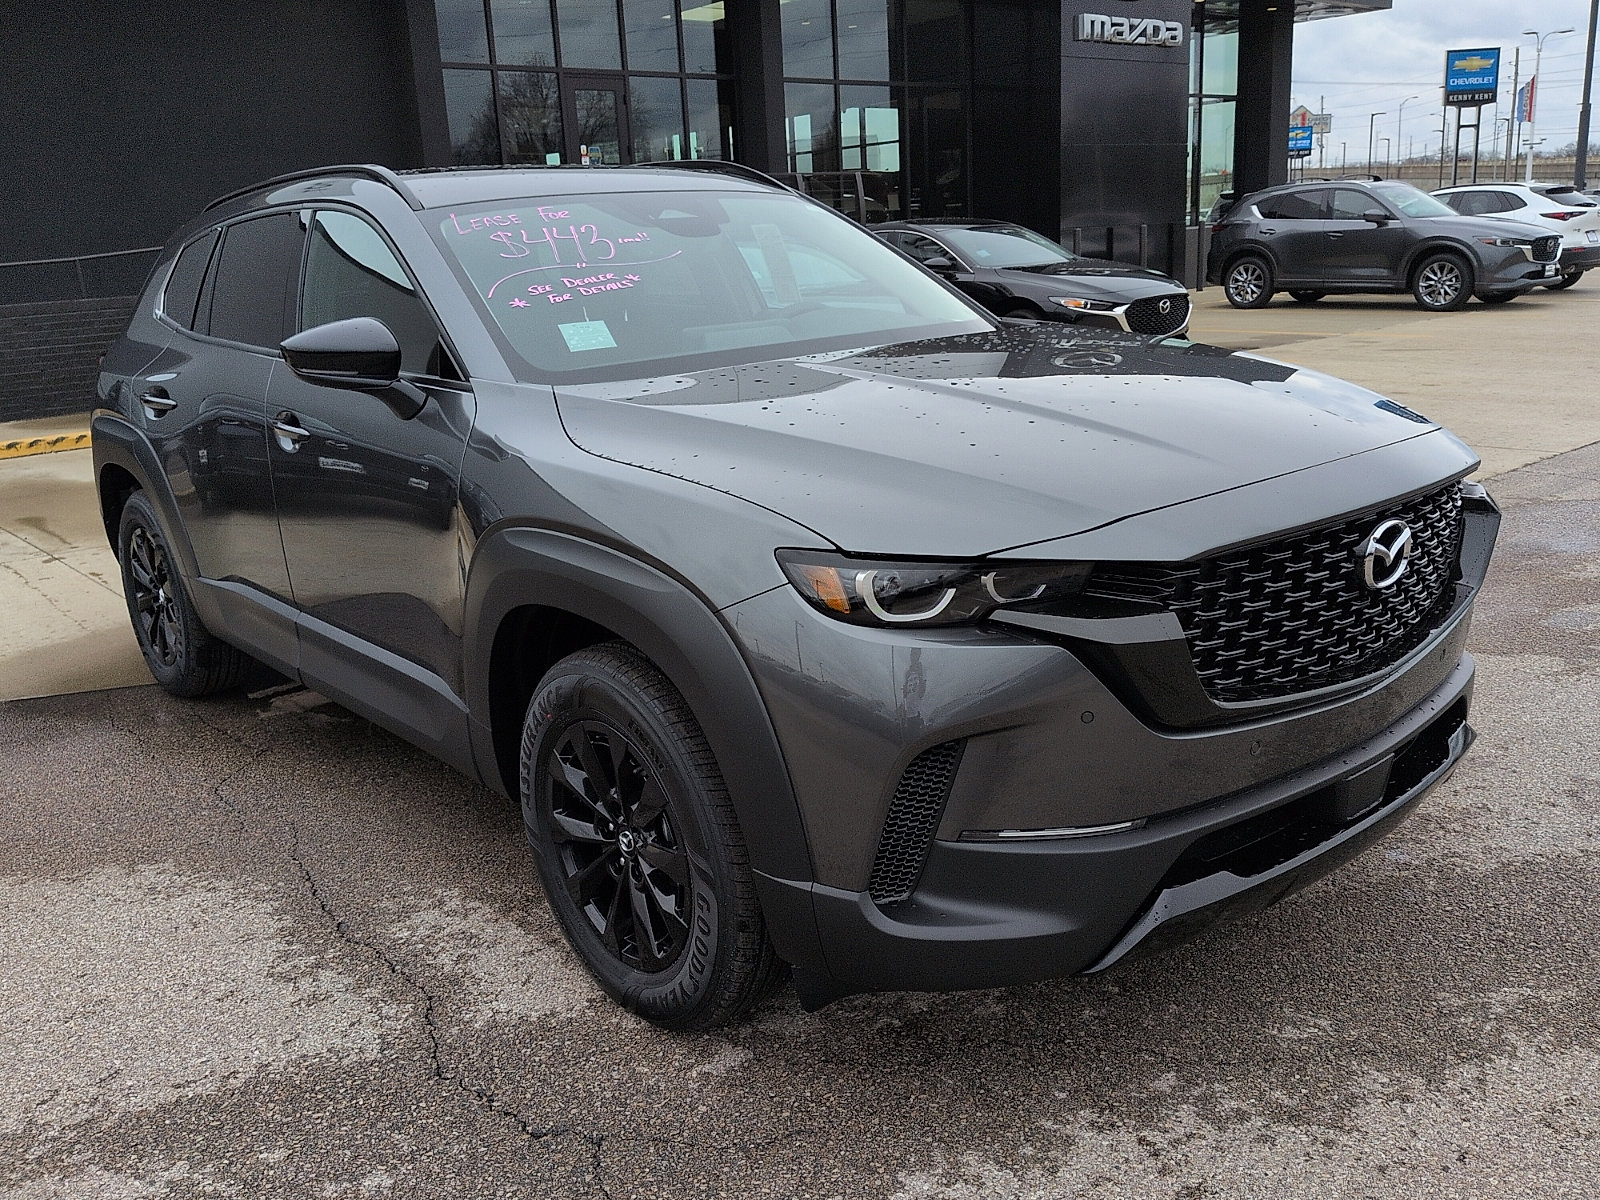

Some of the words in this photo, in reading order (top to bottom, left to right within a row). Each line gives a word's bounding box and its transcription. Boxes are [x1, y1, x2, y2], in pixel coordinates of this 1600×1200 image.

[1078, 13, 1183, 47] mazda
[1449, 76, 1494, 86] CHEVROLET
[1448, 94, 1473, 102] KENNY
[1474, 93, 1493, 101] KENT
[490, 224, 616, 263] $443
[527, 284, 553, 296] SEE
[560, 272, 618, 289] DEALER
[577, 279, 633, 296] DETAILS
[646, 891, 712, 1008] GOODYEAR
